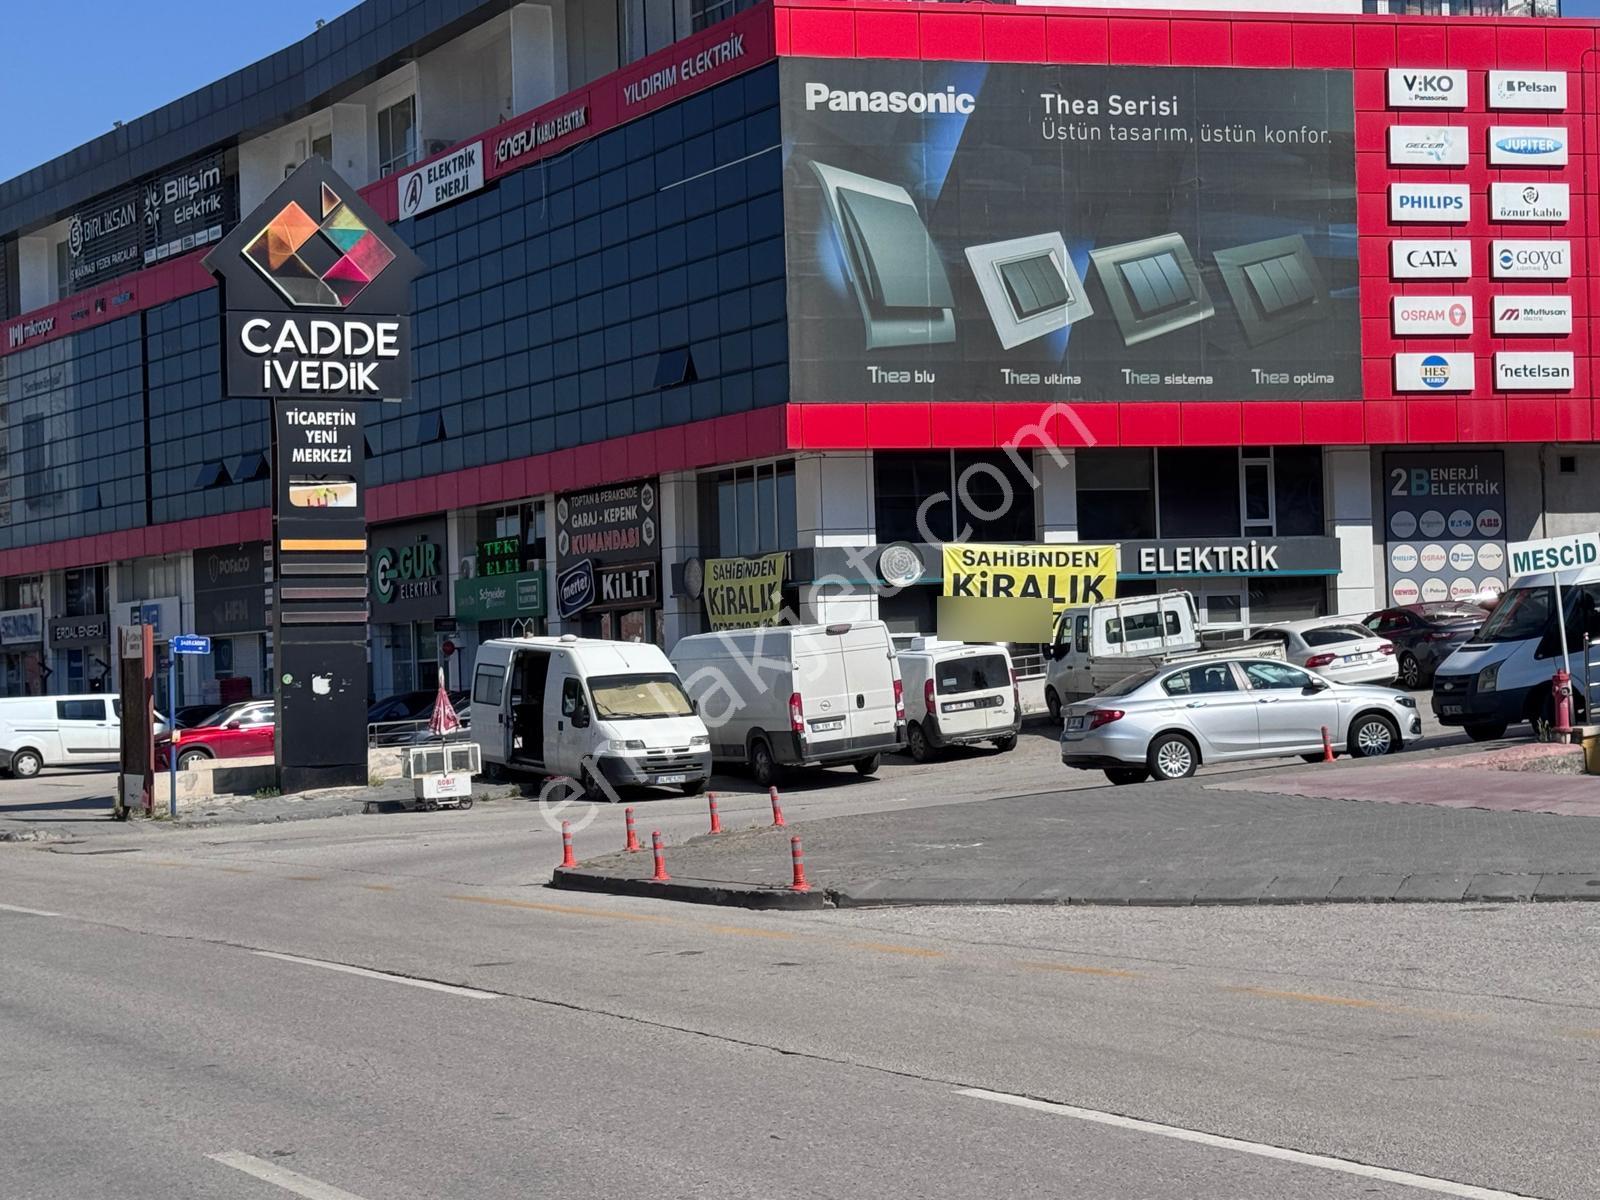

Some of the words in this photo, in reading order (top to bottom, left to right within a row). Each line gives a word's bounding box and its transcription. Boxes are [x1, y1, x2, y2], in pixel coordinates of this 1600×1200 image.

[623, 65, 677, 107] YILDIRIM
[681, 32, 745, 81] ELEKTRİK
[1415, 94, 1448, 102] Panasonic
[1518, 81, 1557, 93] Pelsan
[805, 83, 976, 114] Panasonic
[1040, 93, 1099, 116] Thea
[1108, 93, 1179, 116] Serisi
[536, 119, 556, 145] KABLO
[1042, 120, 1102, 141] Üstün
[1109, 122, 1194, 145] tasarım,
[1200, 124, 1257, 144] üstün
[1264, 124, 1333, 145] konfor.
[1504, 139, 1555, 151] JUPITER
[427, 148, 475, 184] ELEKTRİK
[164, 167, 221, 204] Bilişim
[435, 170, 470, 203] ENERJİ
[174, 194, 221, 224] Elektrik
[1399, 194, 1464, 210] PHILIPS
[1500, 207, 1532, 217] öznur
[1533, 207, 1562, 217] kablo
[84, 202, 136, 242] BİRLİKSAN
[1407, 249, 1458, 269] CATA
[1401, 310, 1445, 321] OSRAM
[24, 316, 55, 338] mikropor
[241, 319, 401, 358] CADDE
[263, 360, 380, 392] İVEDİK
[867, 366, 911, 384] Thea
[914, 368, 936, 384] blu
[1001, 368, 1040, 385] Thea
[1044, 372, 1082, 385] ultima
[1121, 368, 1160, 385] Thea
[1164, 373, 1214, 385] sistema
[1251, 368, 1290, 385] Thea
[1293, 373, 1335, 387] optima
[1424, 367, 1447, 376] HES
[1504, 364, 1570, 378] netelsan
[286, 408, 356, 426] TİCARETİN
[305, 427, 338, 444] YENİ
[292, 445, 352, 463] MERKEZİ
[1391, 467, 1429, 497] 2B
[1431, 464, 1479, 481] ENERJİ
[1431, 480, 1499, 496] ELEKTRİK
[571, 495, 595, 508] TOPTAN
[601, 486, 638, 503] PERAKENDE
[572, 510, 597, 528] GARAJ
[604, 505, 638, 523] KEPENK
[1479, 518, 1500, 528] ABB
[571, 527, 640, 555] KUMANDASI
[961, 549, 1100, 568] SAHİBİNDEN
[1140, 540, 1279, 573] ELEKTRİK
[1513, 539, 1597, 573] MESCİD
[708, 581, 778, 616] KİRALIK
